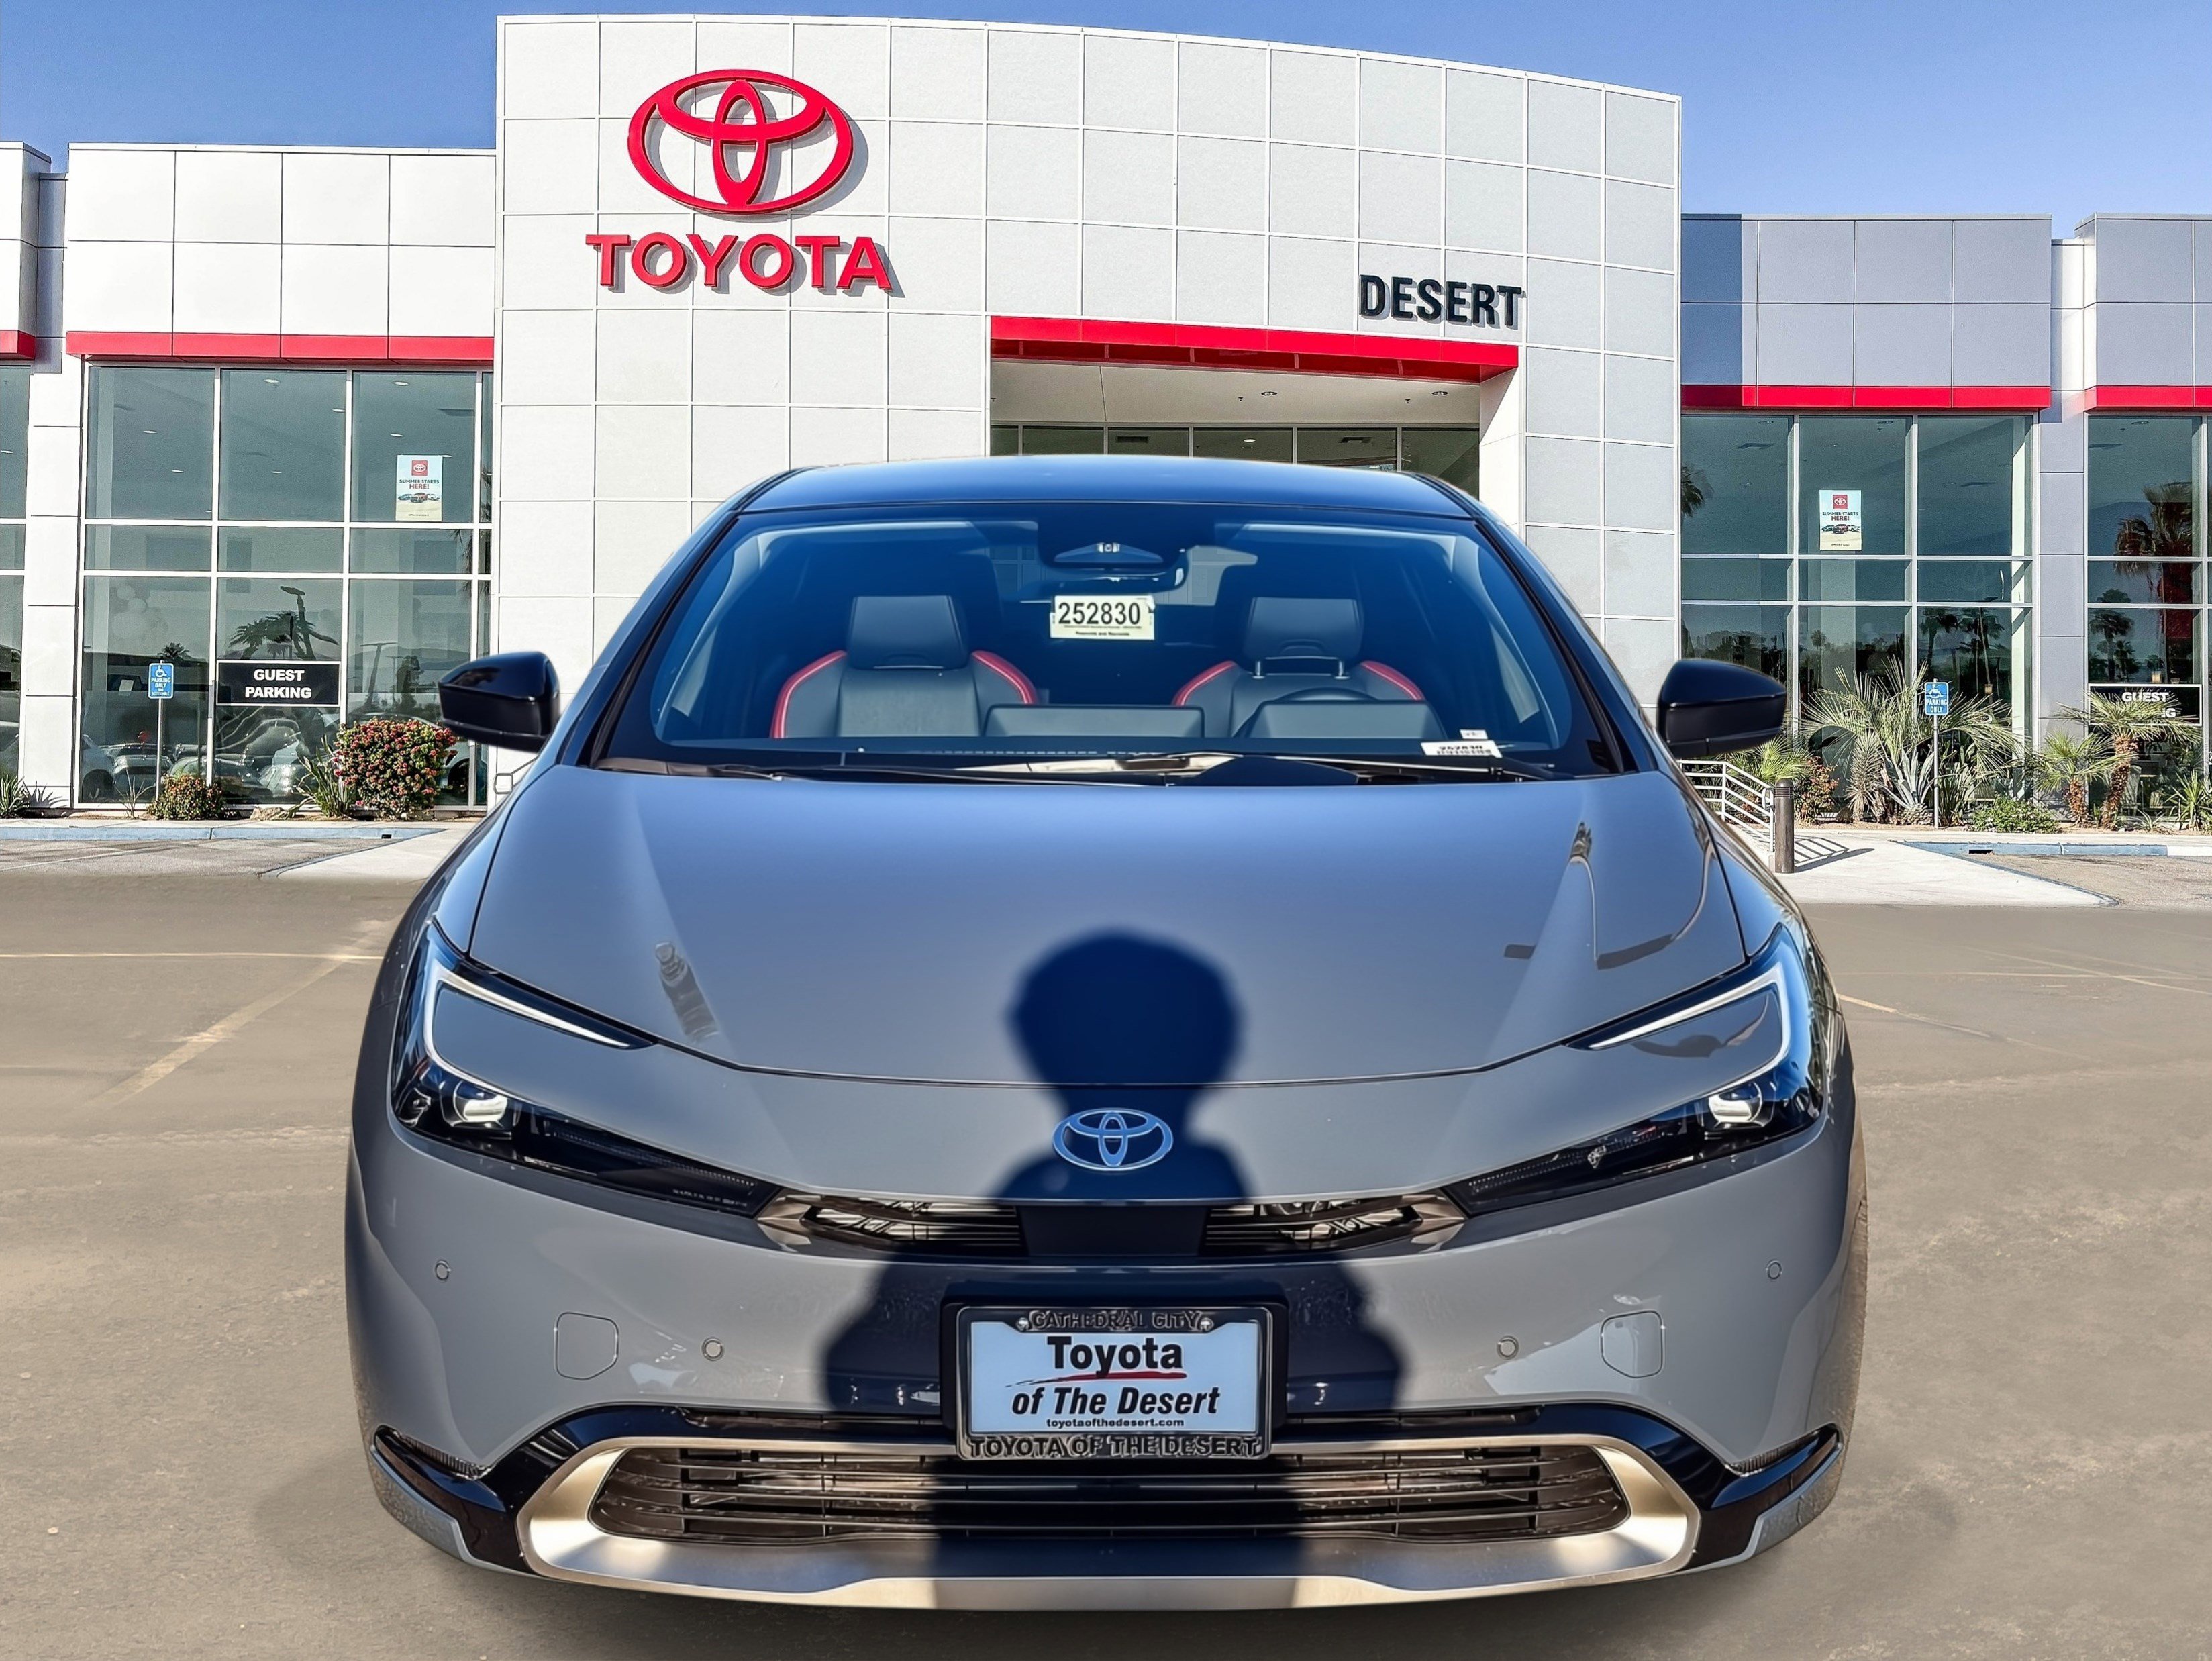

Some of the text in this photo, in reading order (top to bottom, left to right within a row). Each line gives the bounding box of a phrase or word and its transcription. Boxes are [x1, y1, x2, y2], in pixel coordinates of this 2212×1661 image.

[586, 232, 893, 291] TOYOTA
[1359, 274, 1523, 326] DESERT
[1058, 603, 1140, 625] 252830
[253, 669, 305, 681] GUEST
[245, 686, 312, 699] PARKING
[2121, 692, 2169, 703] GUEST
[1029, 1309, 1202, 1331] CATHEDRAL CITY
[1047, 1336, 1183, 1378] Toyota
[1011, 1387, 1220, 1415] of The Desert
[1046, 1417, 1185, 1429] toyotaofthedesert.com
[968, 1436, 1261, 1458] TOYOTA OF THE DESERT
